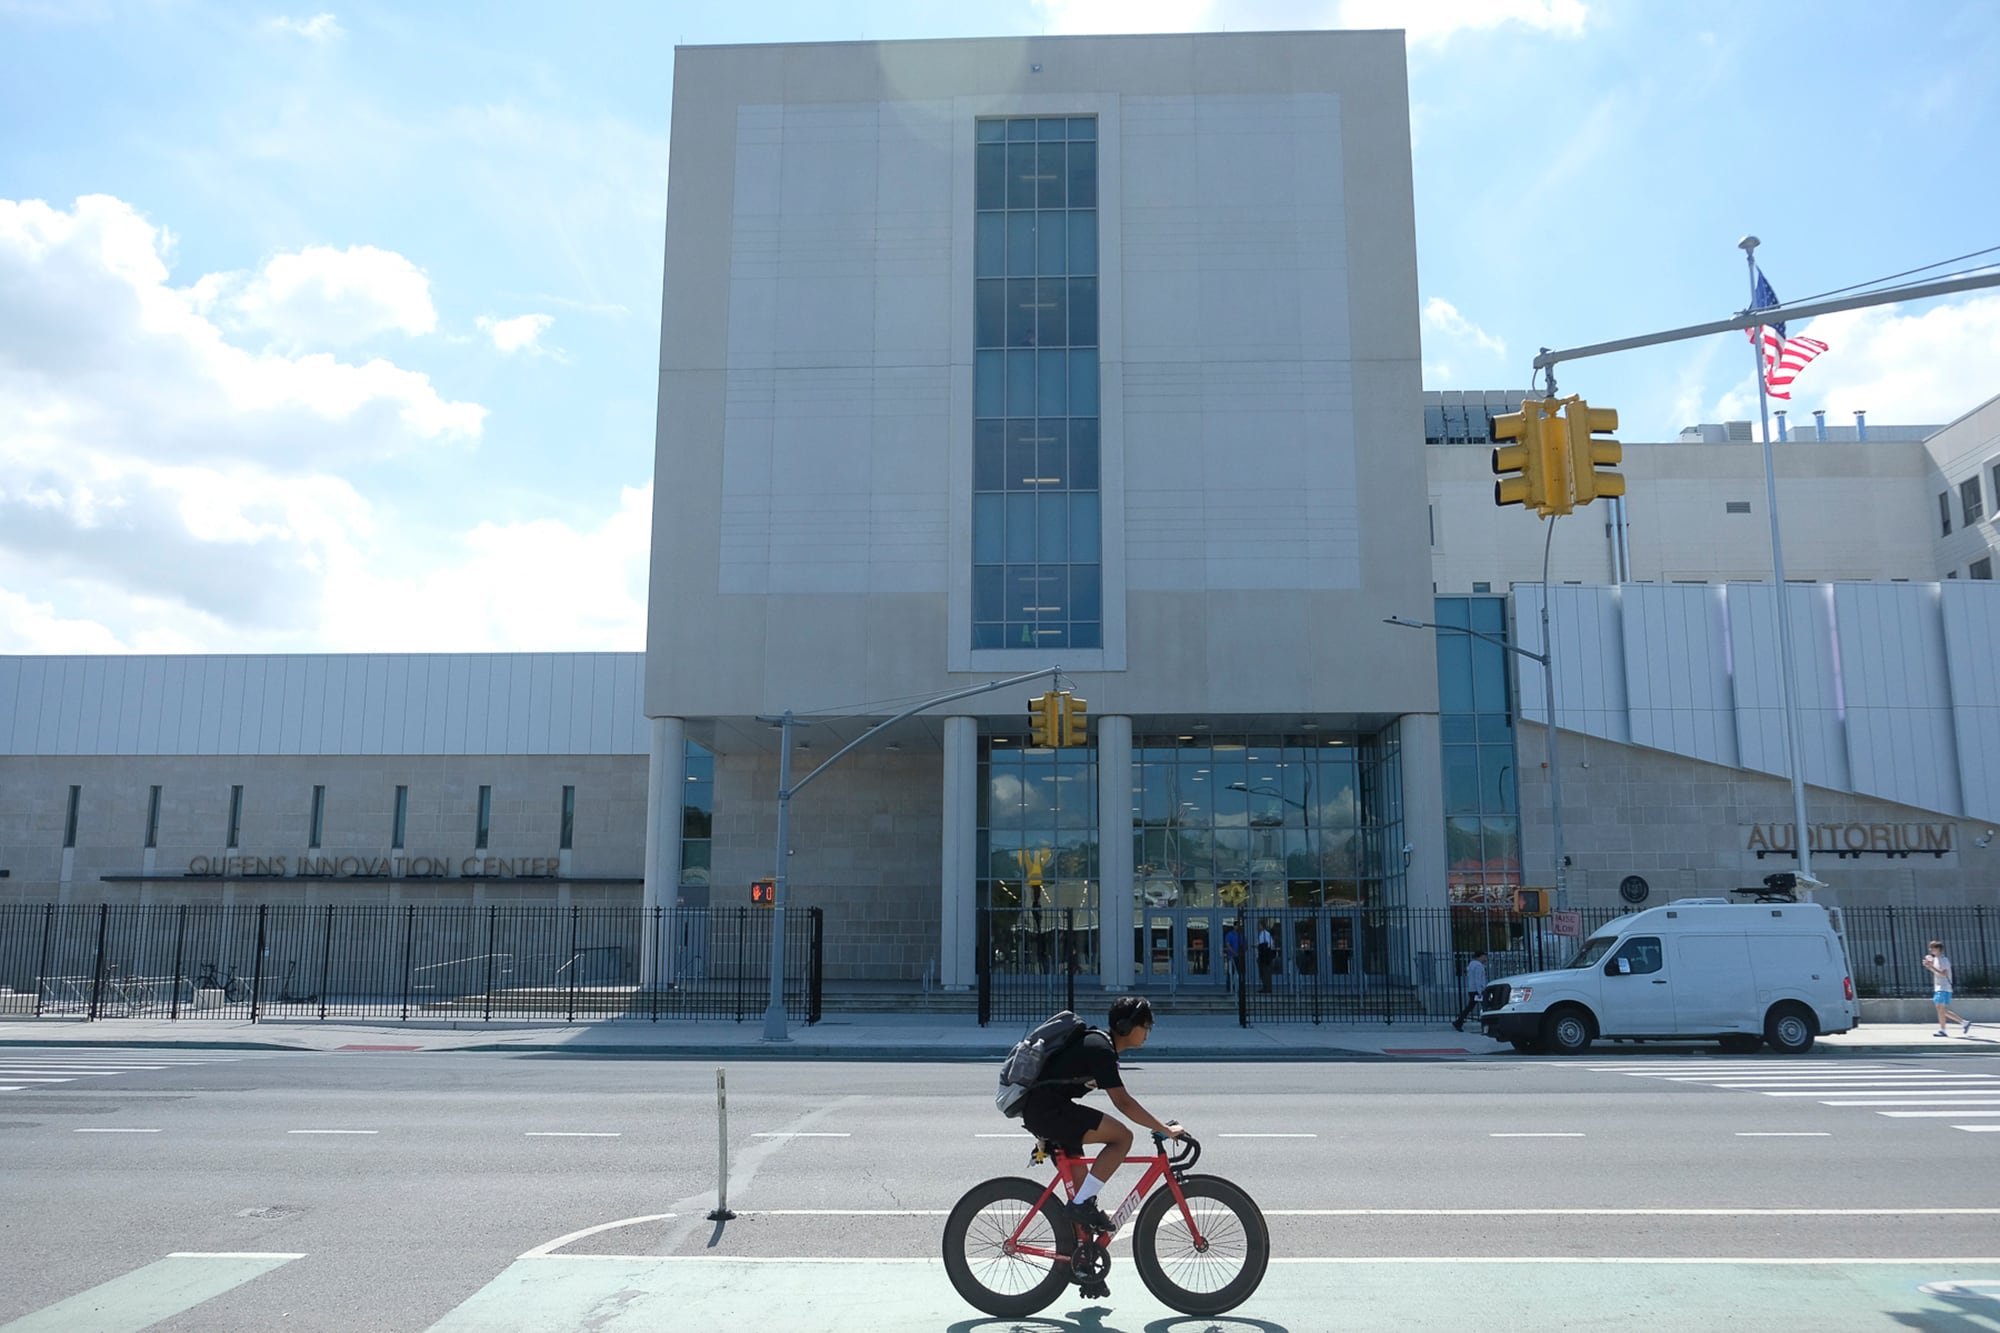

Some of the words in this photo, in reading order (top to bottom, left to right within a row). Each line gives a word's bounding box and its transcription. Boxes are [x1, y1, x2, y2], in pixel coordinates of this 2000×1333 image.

[189, 855, 287, 877] QUEENS
[297, 855, 450, 877] INNOVATION
[461, 856, 561, 877] CENTER
